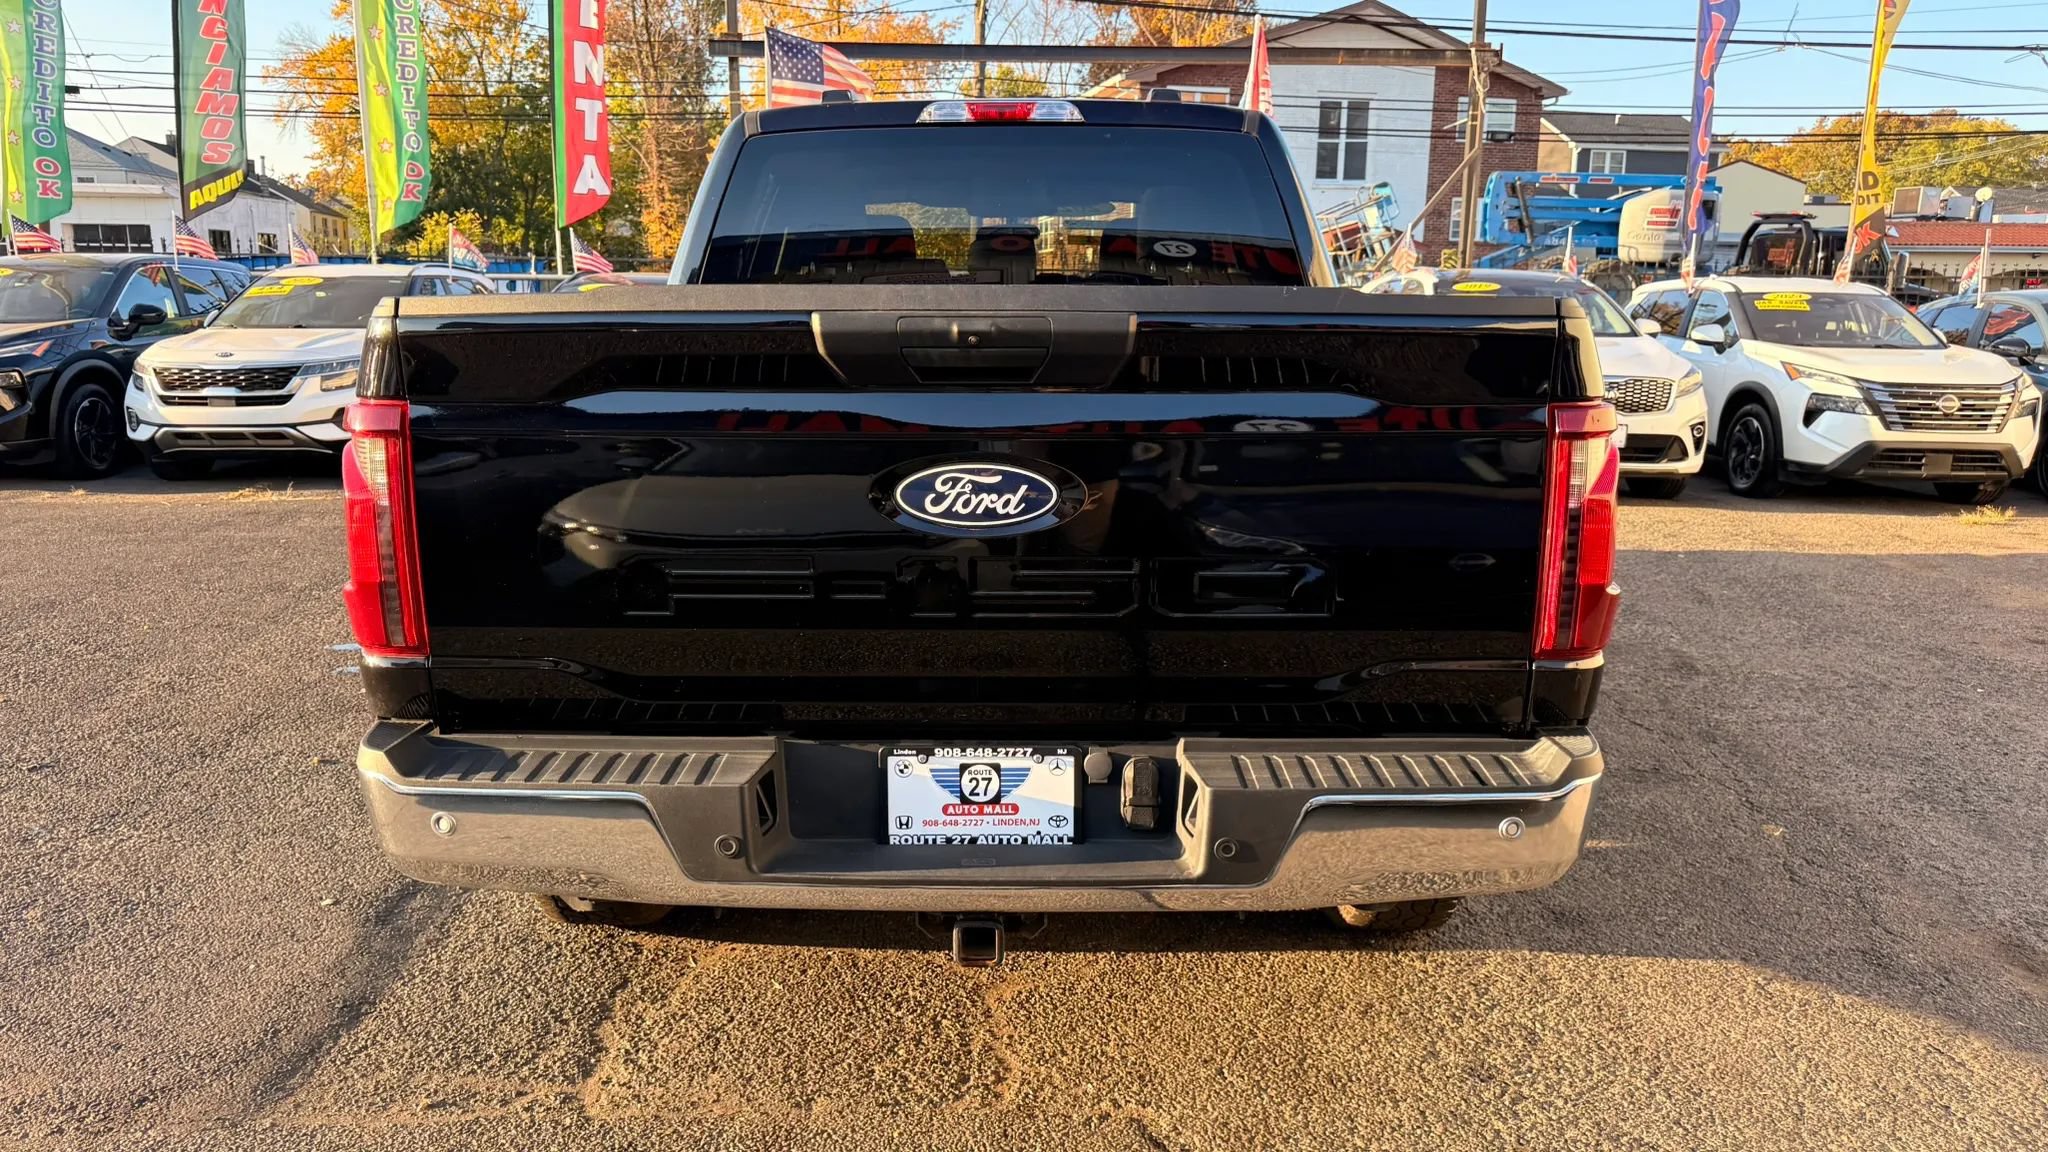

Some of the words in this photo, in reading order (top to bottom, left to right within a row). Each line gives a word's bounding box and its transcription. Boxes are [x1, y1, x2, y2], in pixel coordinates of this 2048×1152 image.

[33, 157, 62, 198] OK
[924, 473, 1028, 514] Ford
[934, 748, 1033, 757] 908-648-2727
[968, 777, 993, 797] 27
[946, 804, 979, 814] AUTO
[983, 804, 1015, 814] MALL
[922, 819, 984, 827] 908-648-2727
[889, 834, 947, 845] ROUTE
[951, 834, 969, 845] 27
[976, 834, 1023, 845] AUTO
[1027, 834, 1073, 845] MALL
